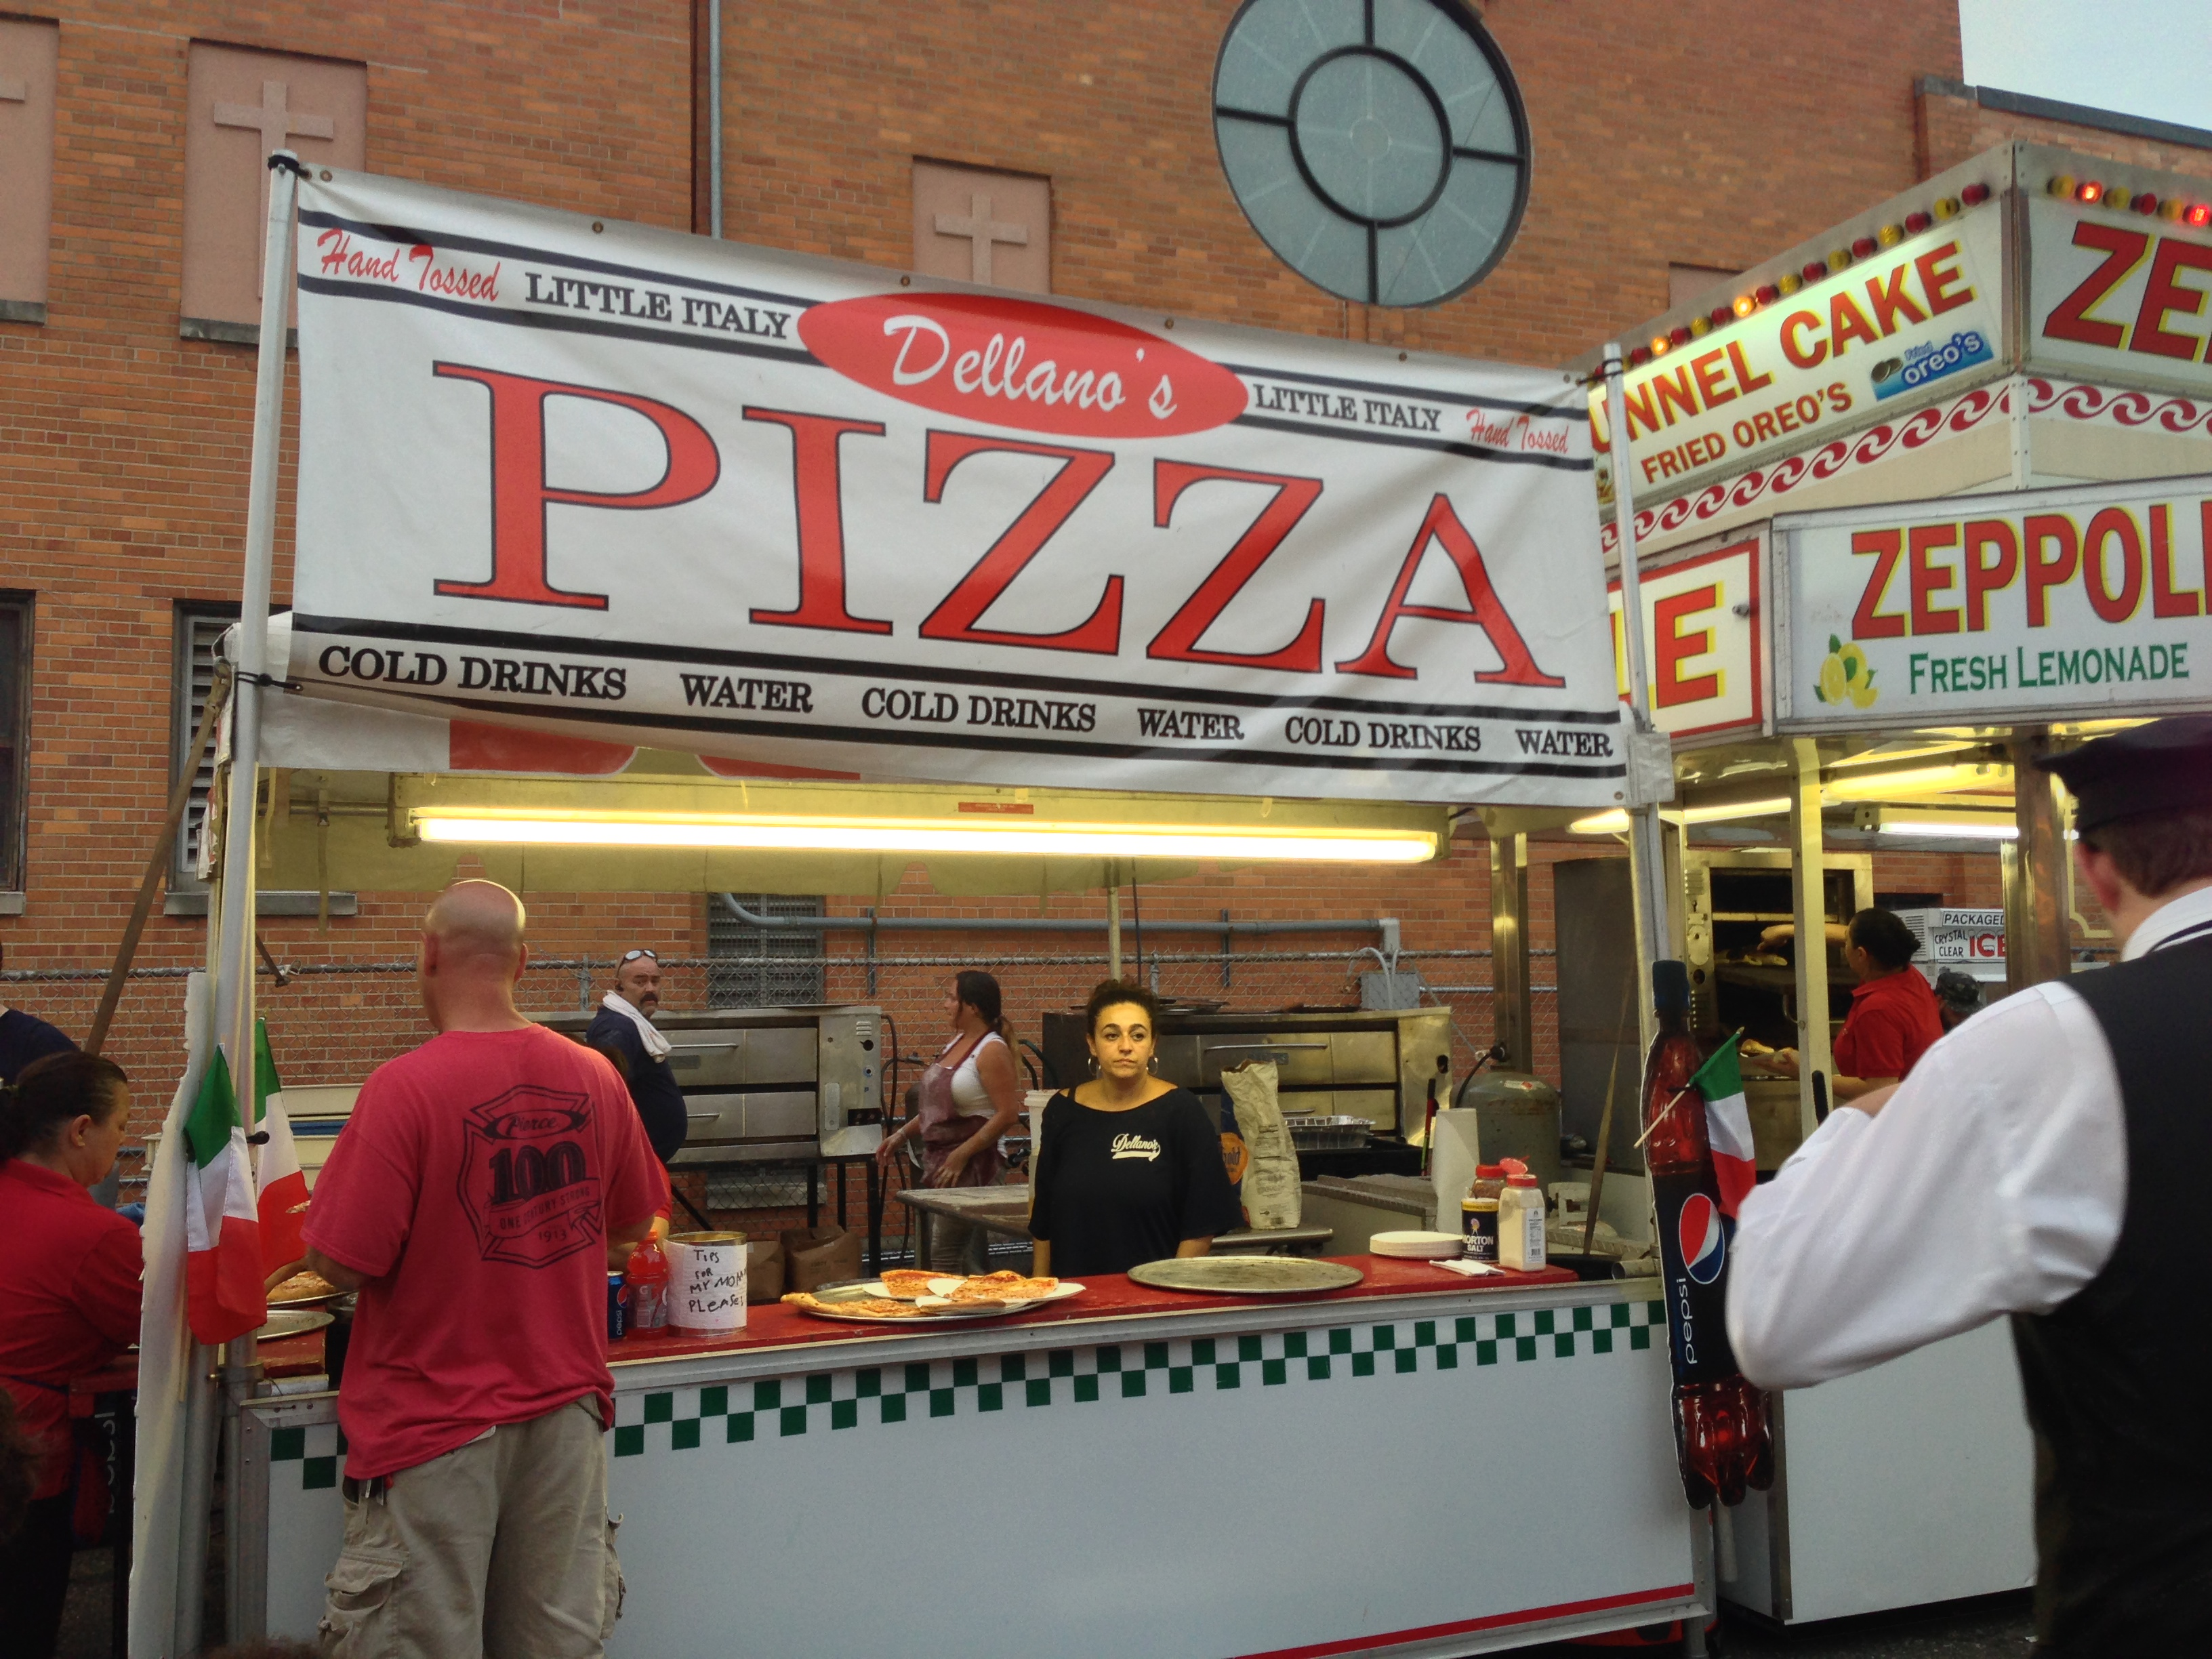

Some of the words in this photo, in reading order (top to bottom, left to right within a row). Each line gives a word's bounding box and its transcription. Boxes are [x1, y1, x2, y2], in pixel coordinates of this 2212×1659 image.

[317, 228, 398, 283] Hand
[409, 245, 500, 302] Tossed
[525, 272, 672, 322] LITTLE
[681, 296, 790, 339] ITALY
[1780, 240, 1976, 371] CAKE
[2042, 220, 2212, 363] ZE
[884, 314, 1176, 419] Dellano's
[1903, 333, 1982, 385] oreo's
[1253, 384, 1357, 422] LITTLE
[1364, 399, 1441, 432] ITALY
[1467, 409, 1510, 447] Hand
[1517, 416, 1569, 454] Tossed
[1640, 432, 1727, 485] FRIED
[1732, 382, 1853, 449] OREO'S
[433, 360, 1566, 689] PIZZA
[319, 645, 447, 686] COLD
[457, 657, 627, 700] DRINKS
[1908, 651, 2009, 695] FRESH
[2018, 641, 2190, 689] LEMONADE
[680, 672, 814, 714] WATER
[862, 688, 958, 722] COLD
[967, 696, 1097, 732] DRINKS
[1137, 708, 1245, 740] WATER
[1285, 716, 1360, 747] COLD
[1368, 722, 1481, 752] DRINKS
[1515, 729, 1614, 757] WATER
[1934, 929, 1968, 945] CRYSTAL
[1939, 946, 1964, 958] CLEAR
[489, 1141, 586, 1205] 100
[499, 1216, 520, 1230] ONE
[539, 1229, 567, 1243] 1913
[690, 1280, 710, 1294] MY
[695, 1267, 713, 1279] FOR
[1677, 1278, 1698, 1364] pepsi
